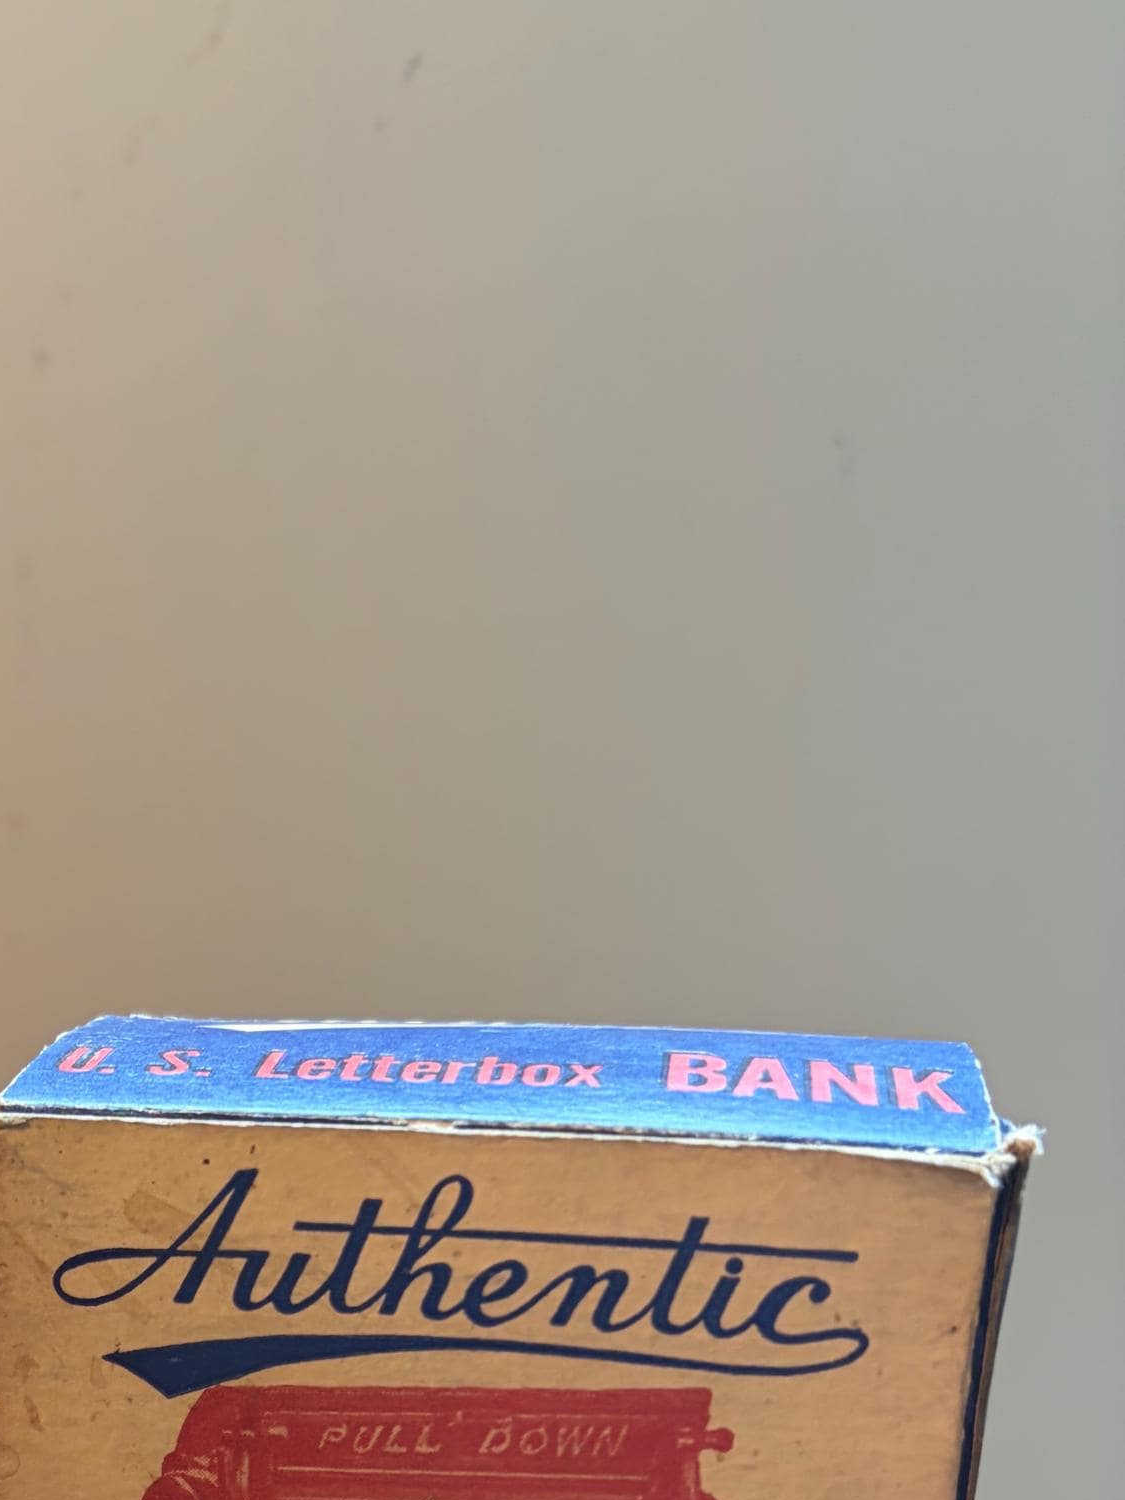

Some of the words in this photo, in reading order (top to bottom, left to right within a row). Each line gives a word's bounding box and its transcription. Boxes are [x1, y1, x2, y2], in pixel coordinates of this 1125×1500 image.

[57, 1046, 117, 1074] U.
[146, 1048, 213, 1078] S.
[253, 1047, 604, 1091] Letterbox
[662, 1050, 967, 1115] BANK
[53, 1167, 869, 1350] Authentic
[317, 1423, 443, 1455] PULL
[478, 1420, 629, 1457] DOWN
